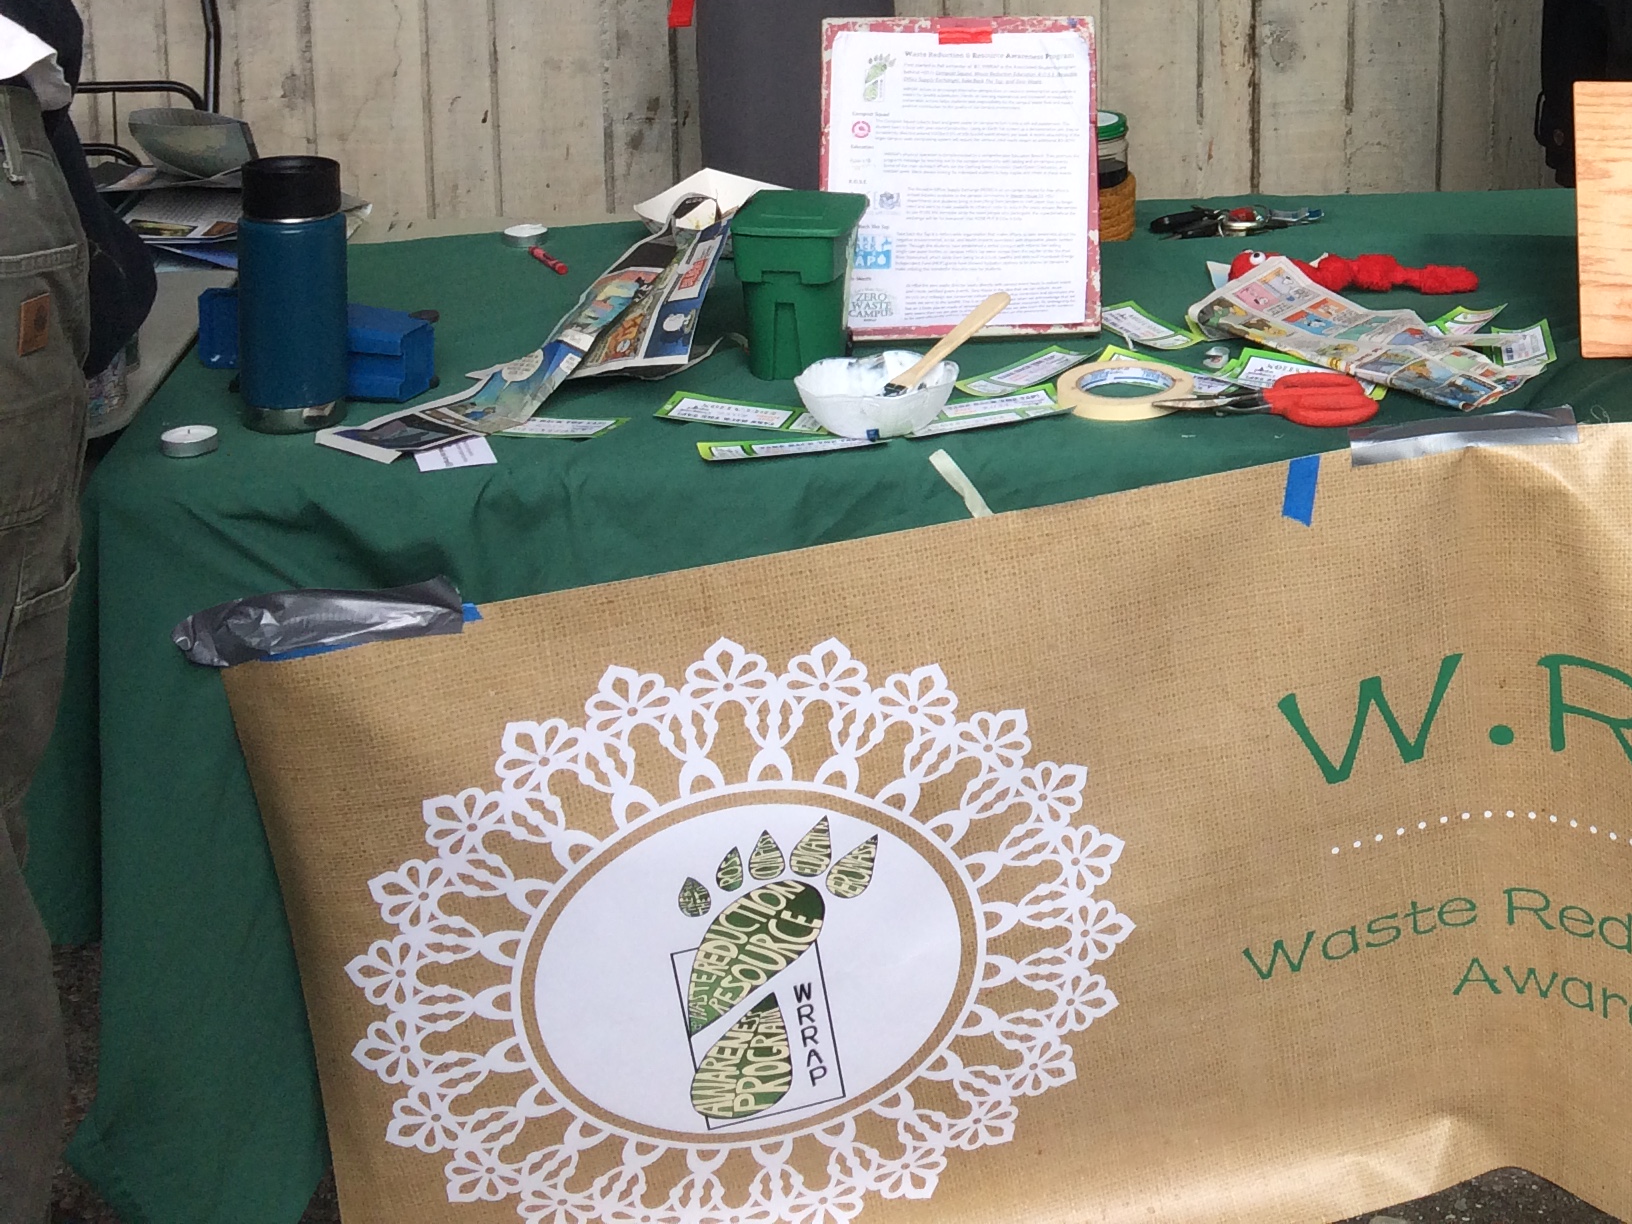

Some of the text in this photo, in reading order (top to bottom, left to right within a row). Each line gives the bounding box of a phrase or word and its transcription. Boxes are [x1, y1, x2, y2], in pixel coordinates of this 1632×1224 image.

[851, 301, 891, 311] WASTE
[856, 292, 887, 301] ZERO
[694, 880, 806, 977] REDUCTION
[708, 910, 823, 1015] RESOURCE
[1242, 896, 1478, 980] Waste
